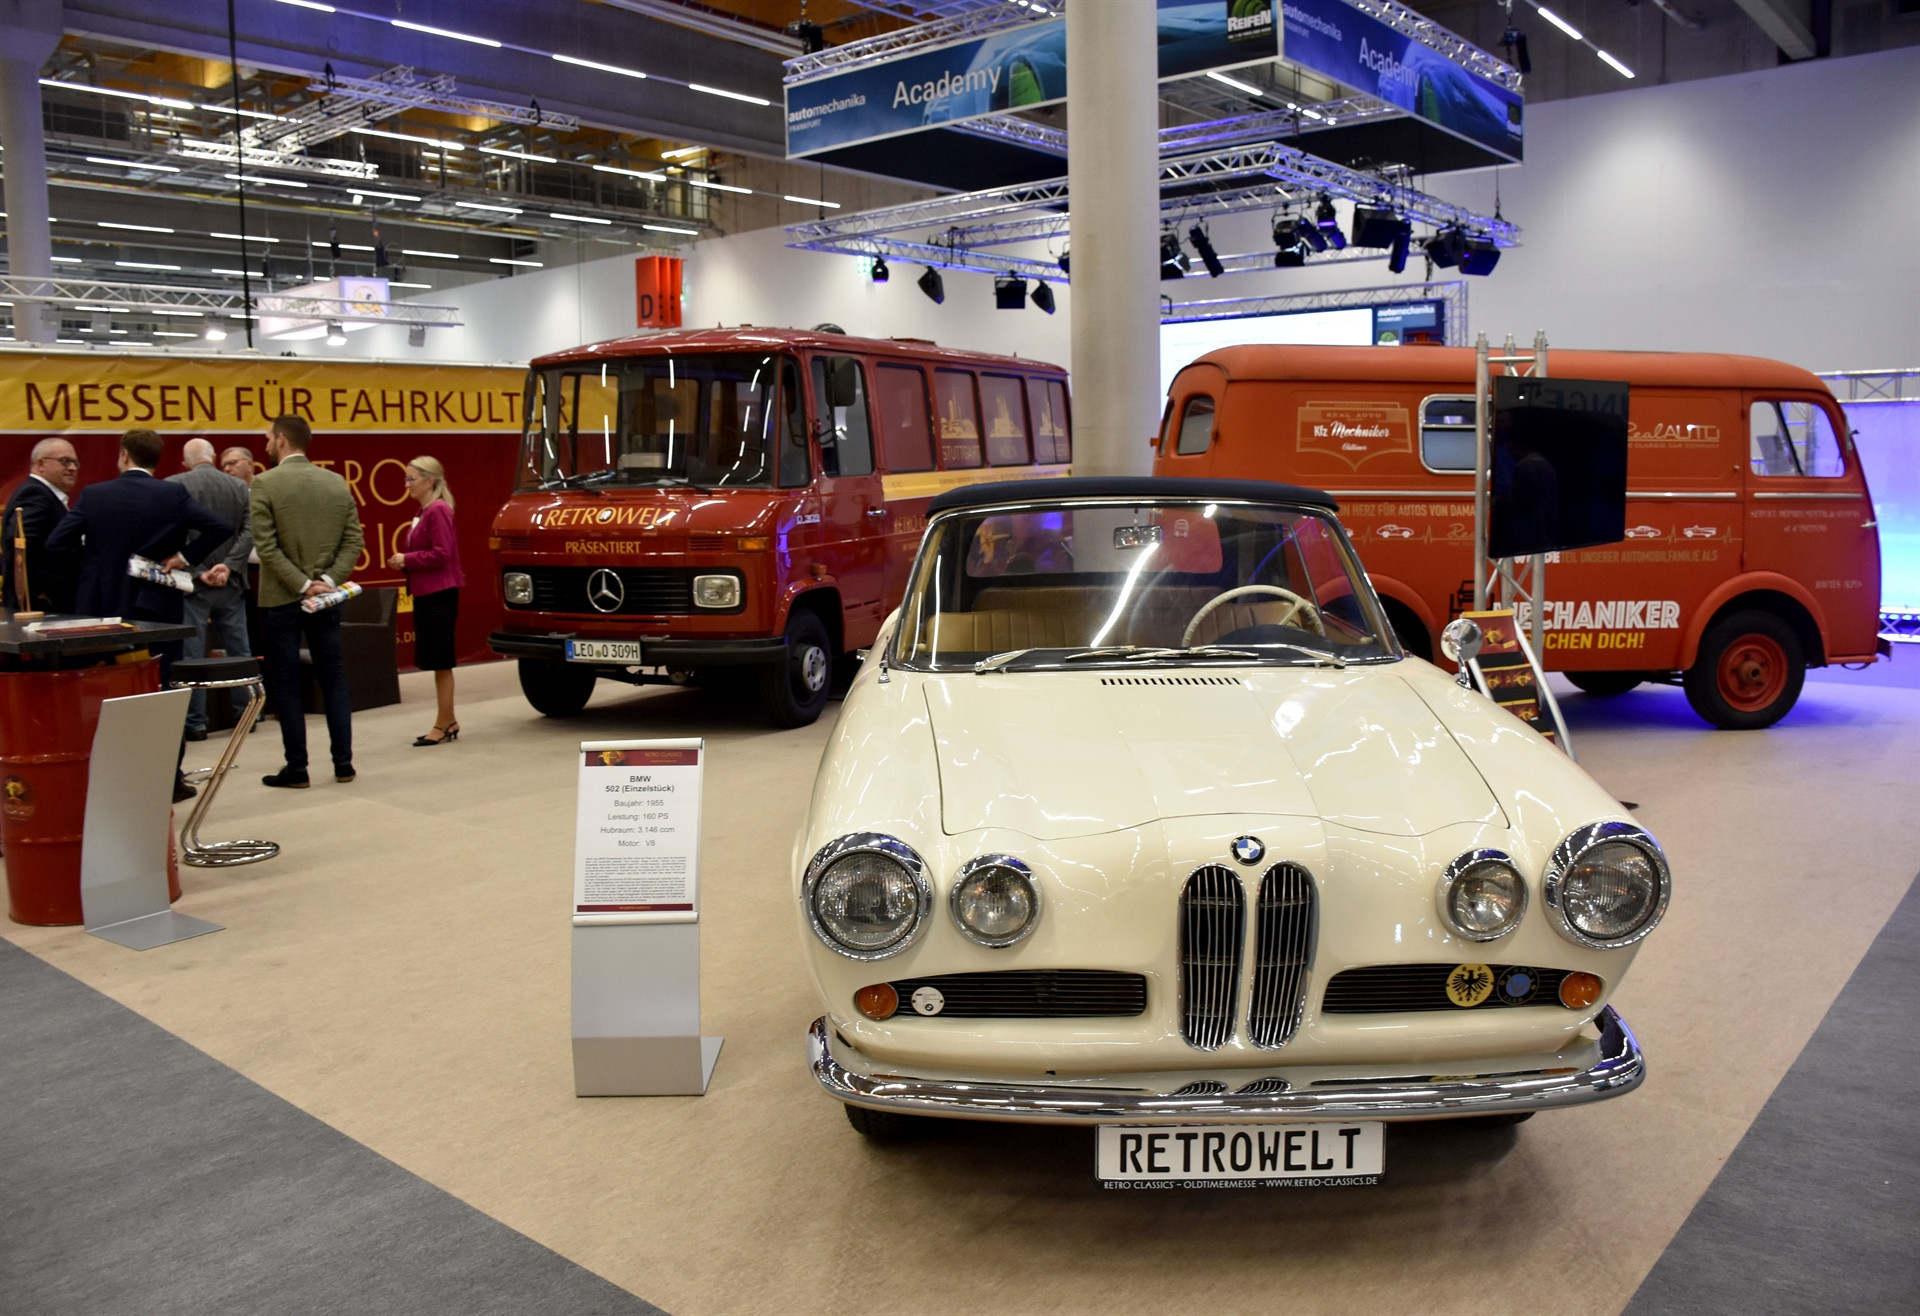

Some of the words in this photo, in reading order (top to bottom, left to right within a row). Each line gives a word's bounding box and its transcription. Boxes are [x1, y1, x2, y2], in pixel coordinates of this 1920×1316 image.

[1227, 10, 1272, 32] REIFEN
[1359, 37, 1420, 97] Academy
[892, 66, 1002, 109] Academy
[788, 93, 866, 123] automechanika
[641, 294, 653, 319] D
[25, 382, 216, 422] MESSEN
[236, 380, 315, 422] FÜR
[331, 389, 568, 423] FAHRKULTR
[544, 506, 681, 527] RETROWELT
[1352, 504, 1376, 516] HERZ
[1378, 503, 1395, 516] FÜR
[1399, 504, 1427, 516] AUTOS
[1429, 504, 1449, 516] VON
[565, 539, 642, 553] PRÄSENTIERT
[1580, 550, 1619, 563] UNSERER
[1621, 550, 1699, 562] AUTOMOBILFAMILIE
[1702, 550, 1718, 562] ALS
[1598, 633, 1645, 649] DICH!
[573, 643, 594, 657] LEO
[611, 644, 639, 659] 309H
[630, 775, 651, 783] BMW
[605, 785, 620, 793] 502
[622, 785, 675, 794] (Einzelstück)
[614, 800, 644, 808] Baujahr:
[608, 813, 640, 821] Leistung:
[1120, 1128, 1361, 1173] RETROWELT
[1104, 1181, 1131, 1189] RETRO
[1134, 1181, 1174, 1189] CLASSICS
[1184, 1179, 1256, 1188] OLDTIMERMESSE
[1266, 1177, 1378, 1187] WWW.RETRO-CLASSICS.DE
